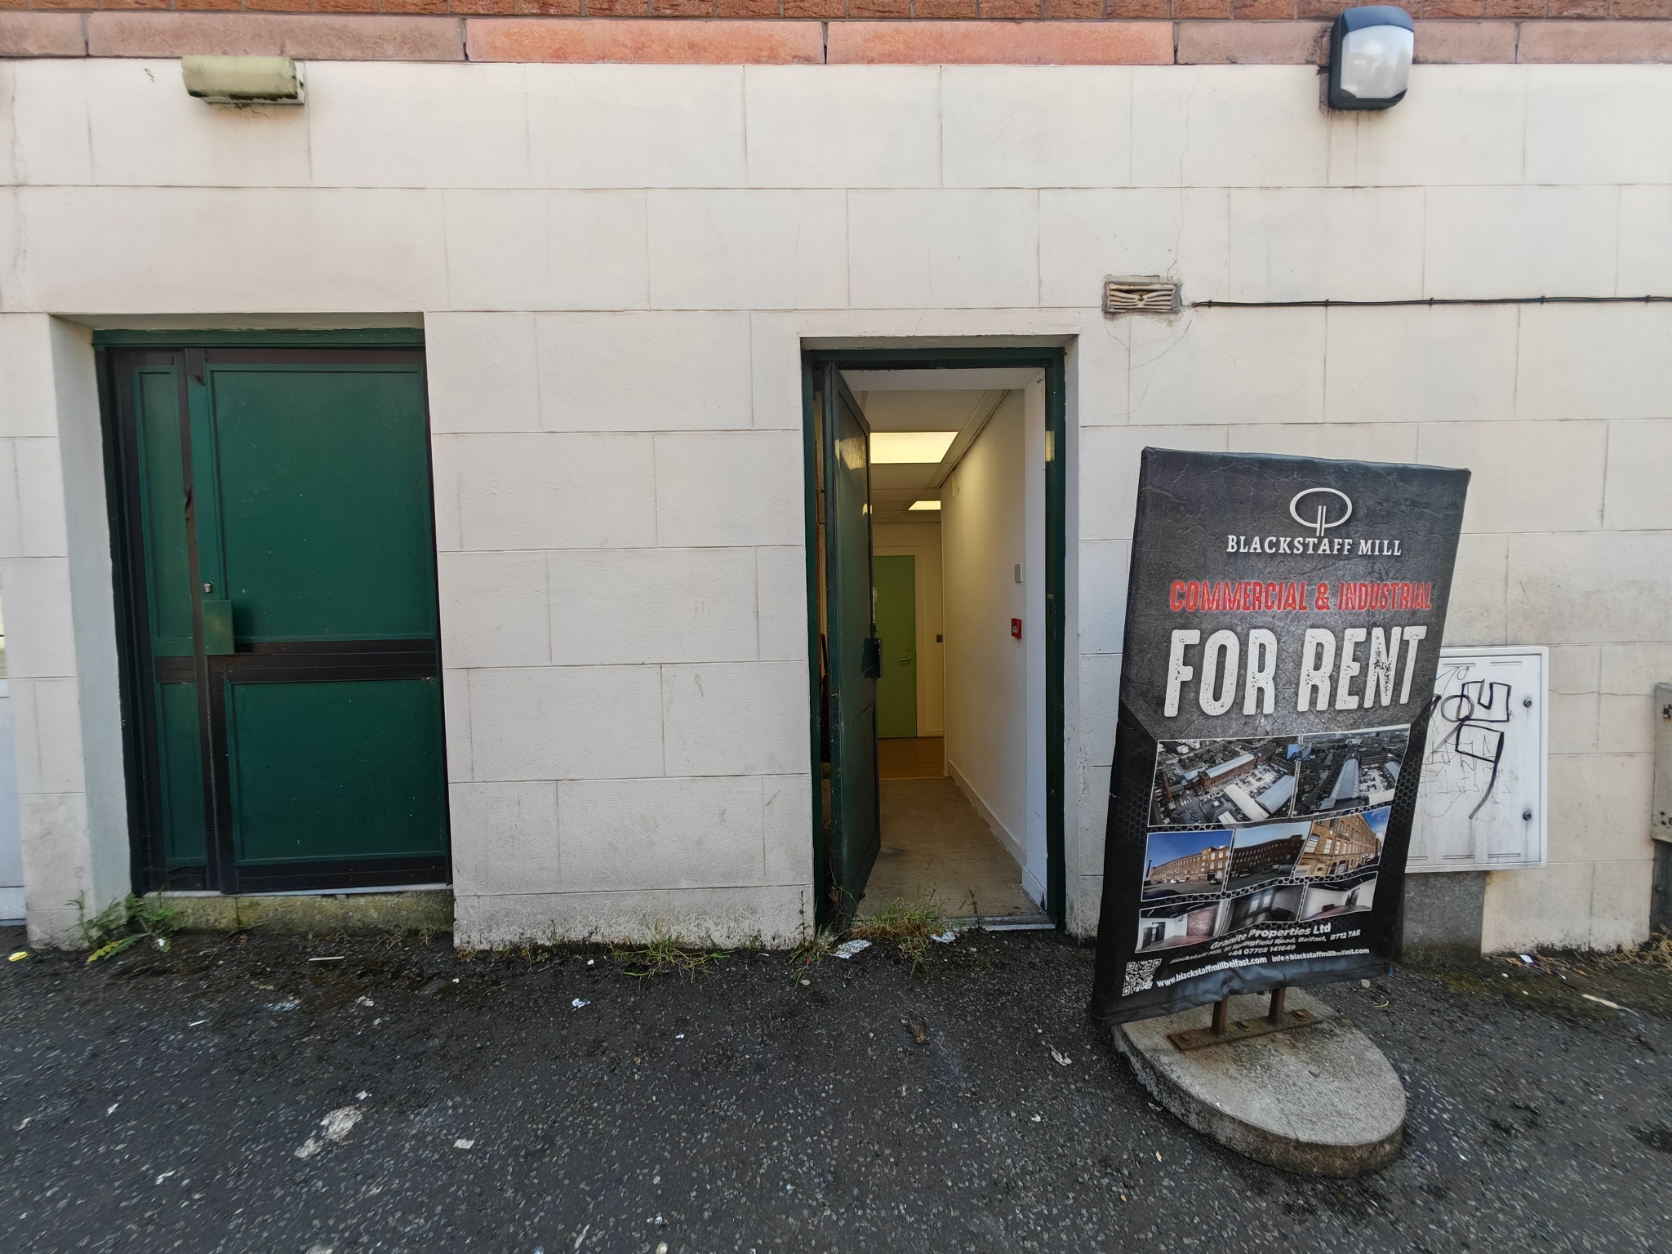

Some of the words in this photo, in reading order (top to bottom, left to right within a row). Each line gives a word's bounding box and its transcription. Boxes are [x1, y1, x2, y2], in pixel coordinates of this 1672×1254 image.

[1227, 535, 1353, 555] BLACKSTAFF
[1358, 538, 1402, 556] MILL
[1170, 580, 1308, 612] COMMERCIAL
[1314, 582, 1331, 611] &
[1337, 582, 1432, 611] INDUSTRIAL
[1164, 628, 1278, 717] FOR
[1297, 625, 1428, 712] RENT
[1210, 933, 1247, 949] Granite
[1248, 928, 1311, 938] Properties
[1313, 922, 1332, 935] Ltd
[1156, 957, 1267, 987] www.blackstaffmillbelfast.com
